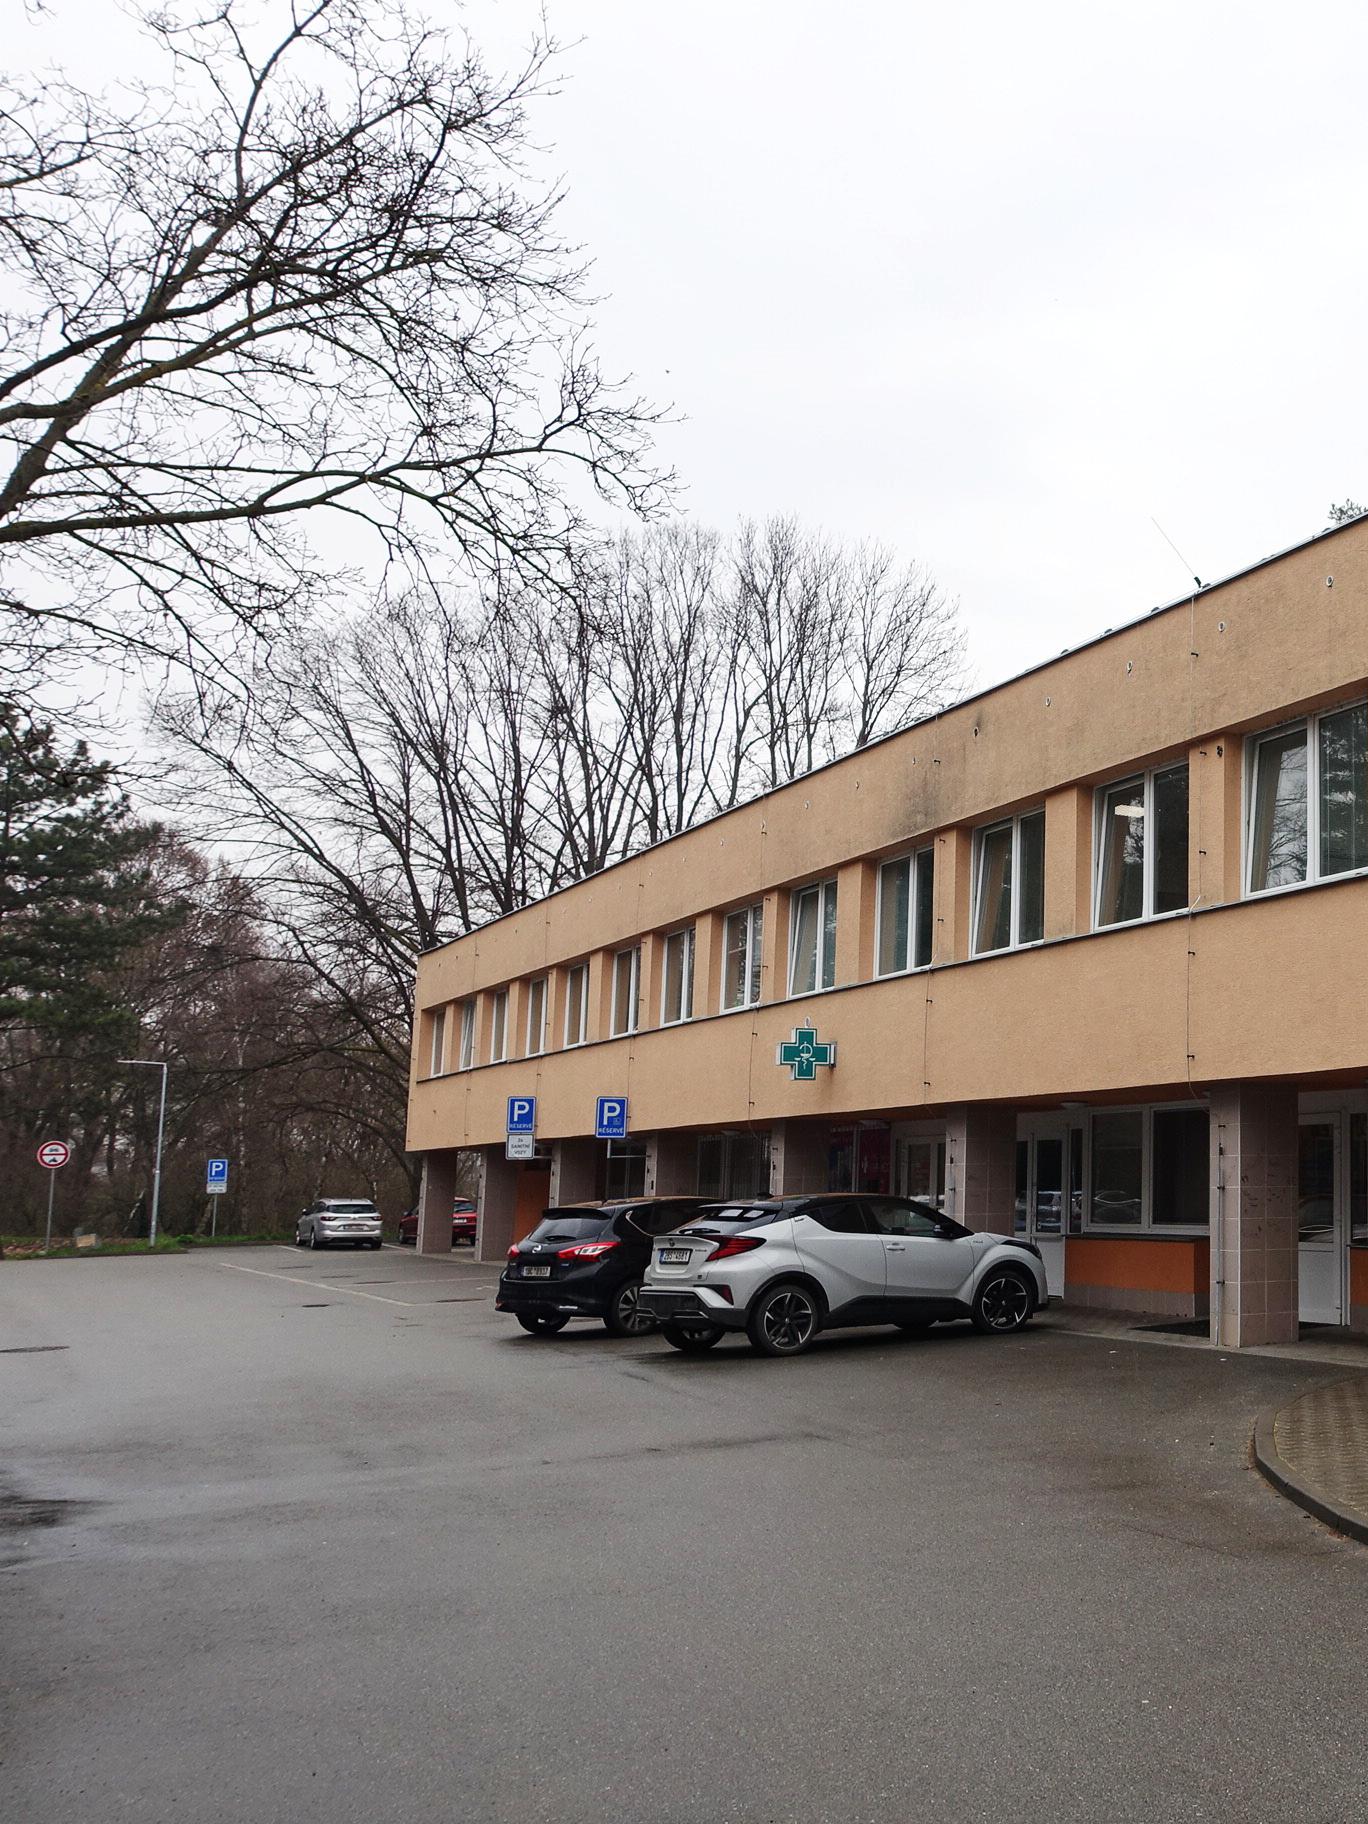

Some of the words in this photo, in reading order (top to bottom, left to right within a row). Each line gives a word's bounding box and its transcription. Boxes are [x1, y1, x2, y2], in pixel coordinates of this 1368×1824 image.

[513, 1101, 530, 1122] P
[603, 1102, 621, 1126] P
[211, 1162, 223, 1176] P
